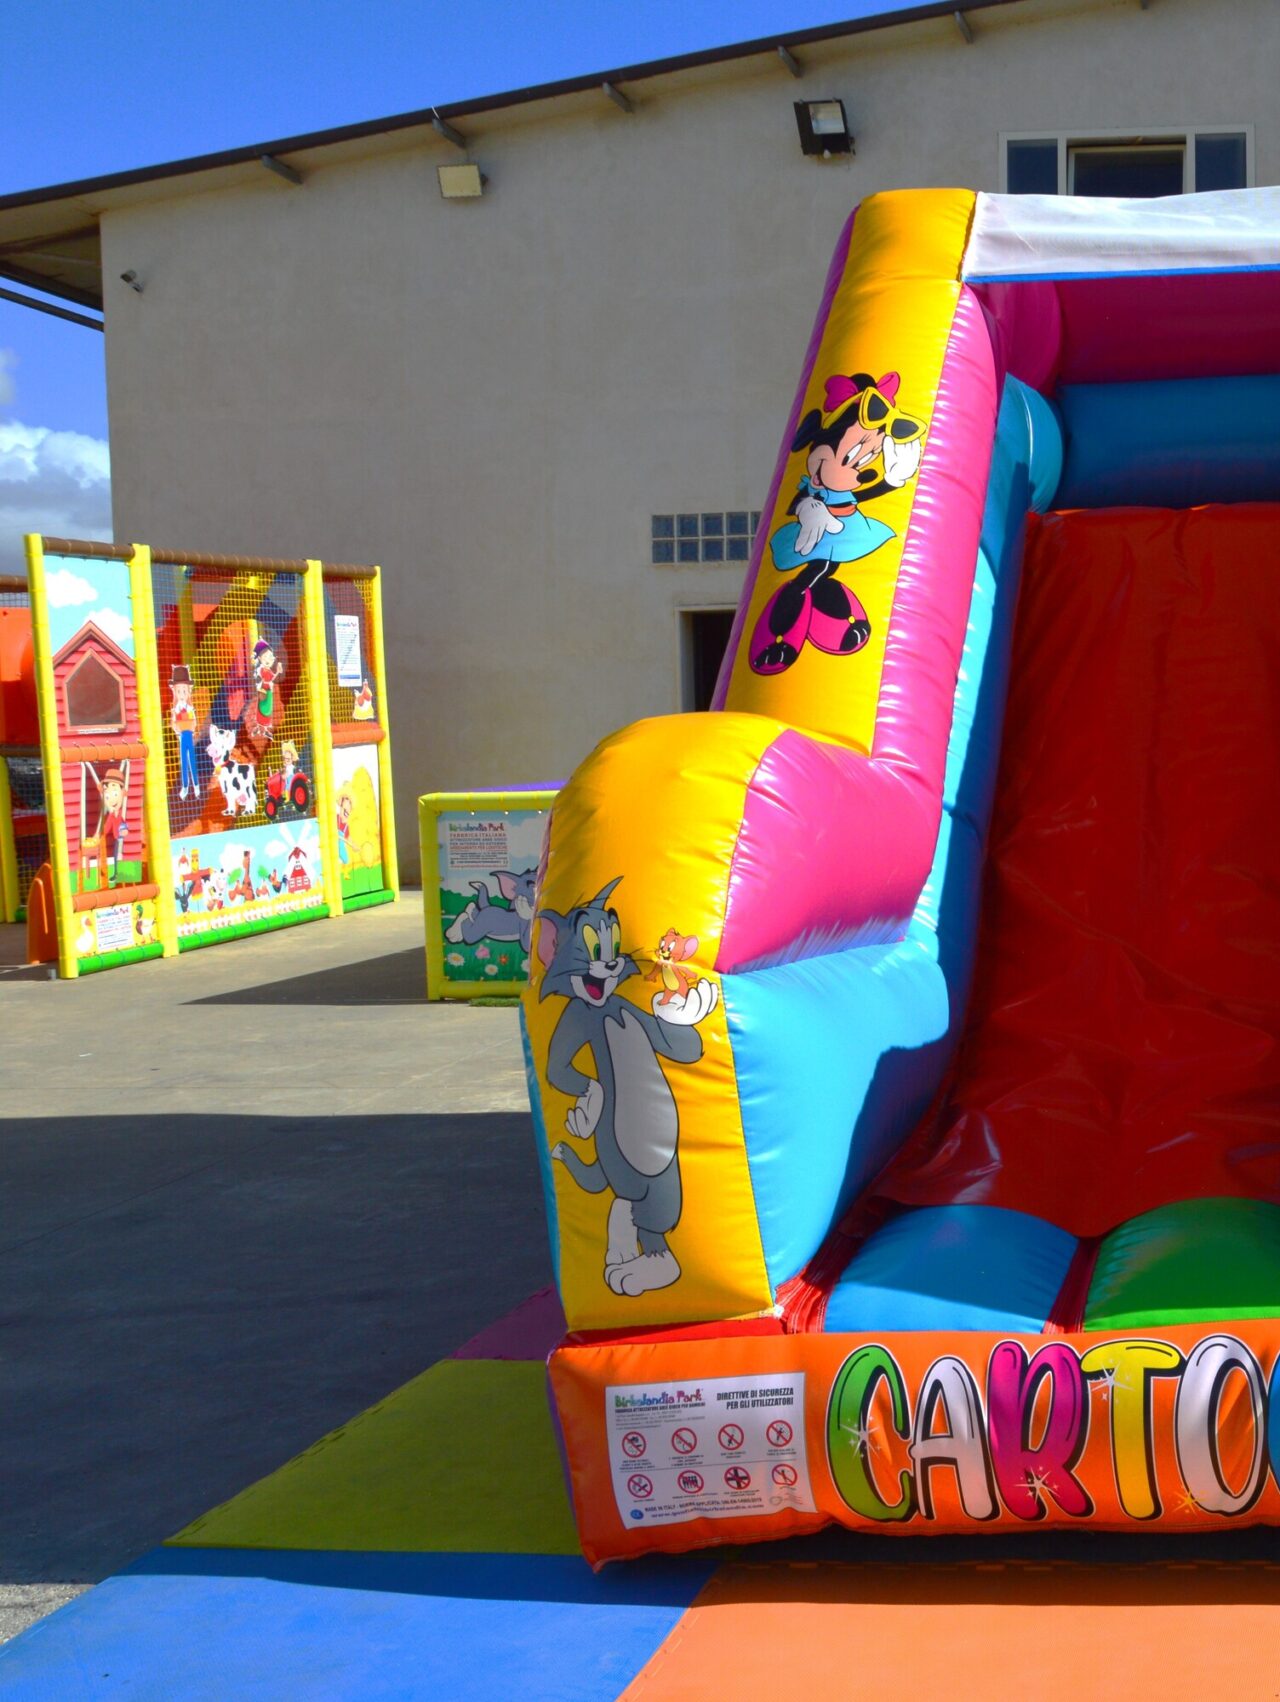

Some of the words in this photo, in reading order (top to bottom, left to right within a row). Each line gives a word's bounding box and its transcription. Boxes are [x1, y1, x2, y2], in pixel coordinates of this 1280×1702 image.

[677, 1388, 702, 1403] Park
[716, 1390, 749, 1401] DIRETTIVE
[750, 1390, 758, 1398] DI
[758, 1387, 794, 1398] SICUREZZA
[726, 1400, 739, 1410] PER
[740, 1399, 750, 1409] GLI
[751, 1397, 794, 1408] UTILIZZATORI
